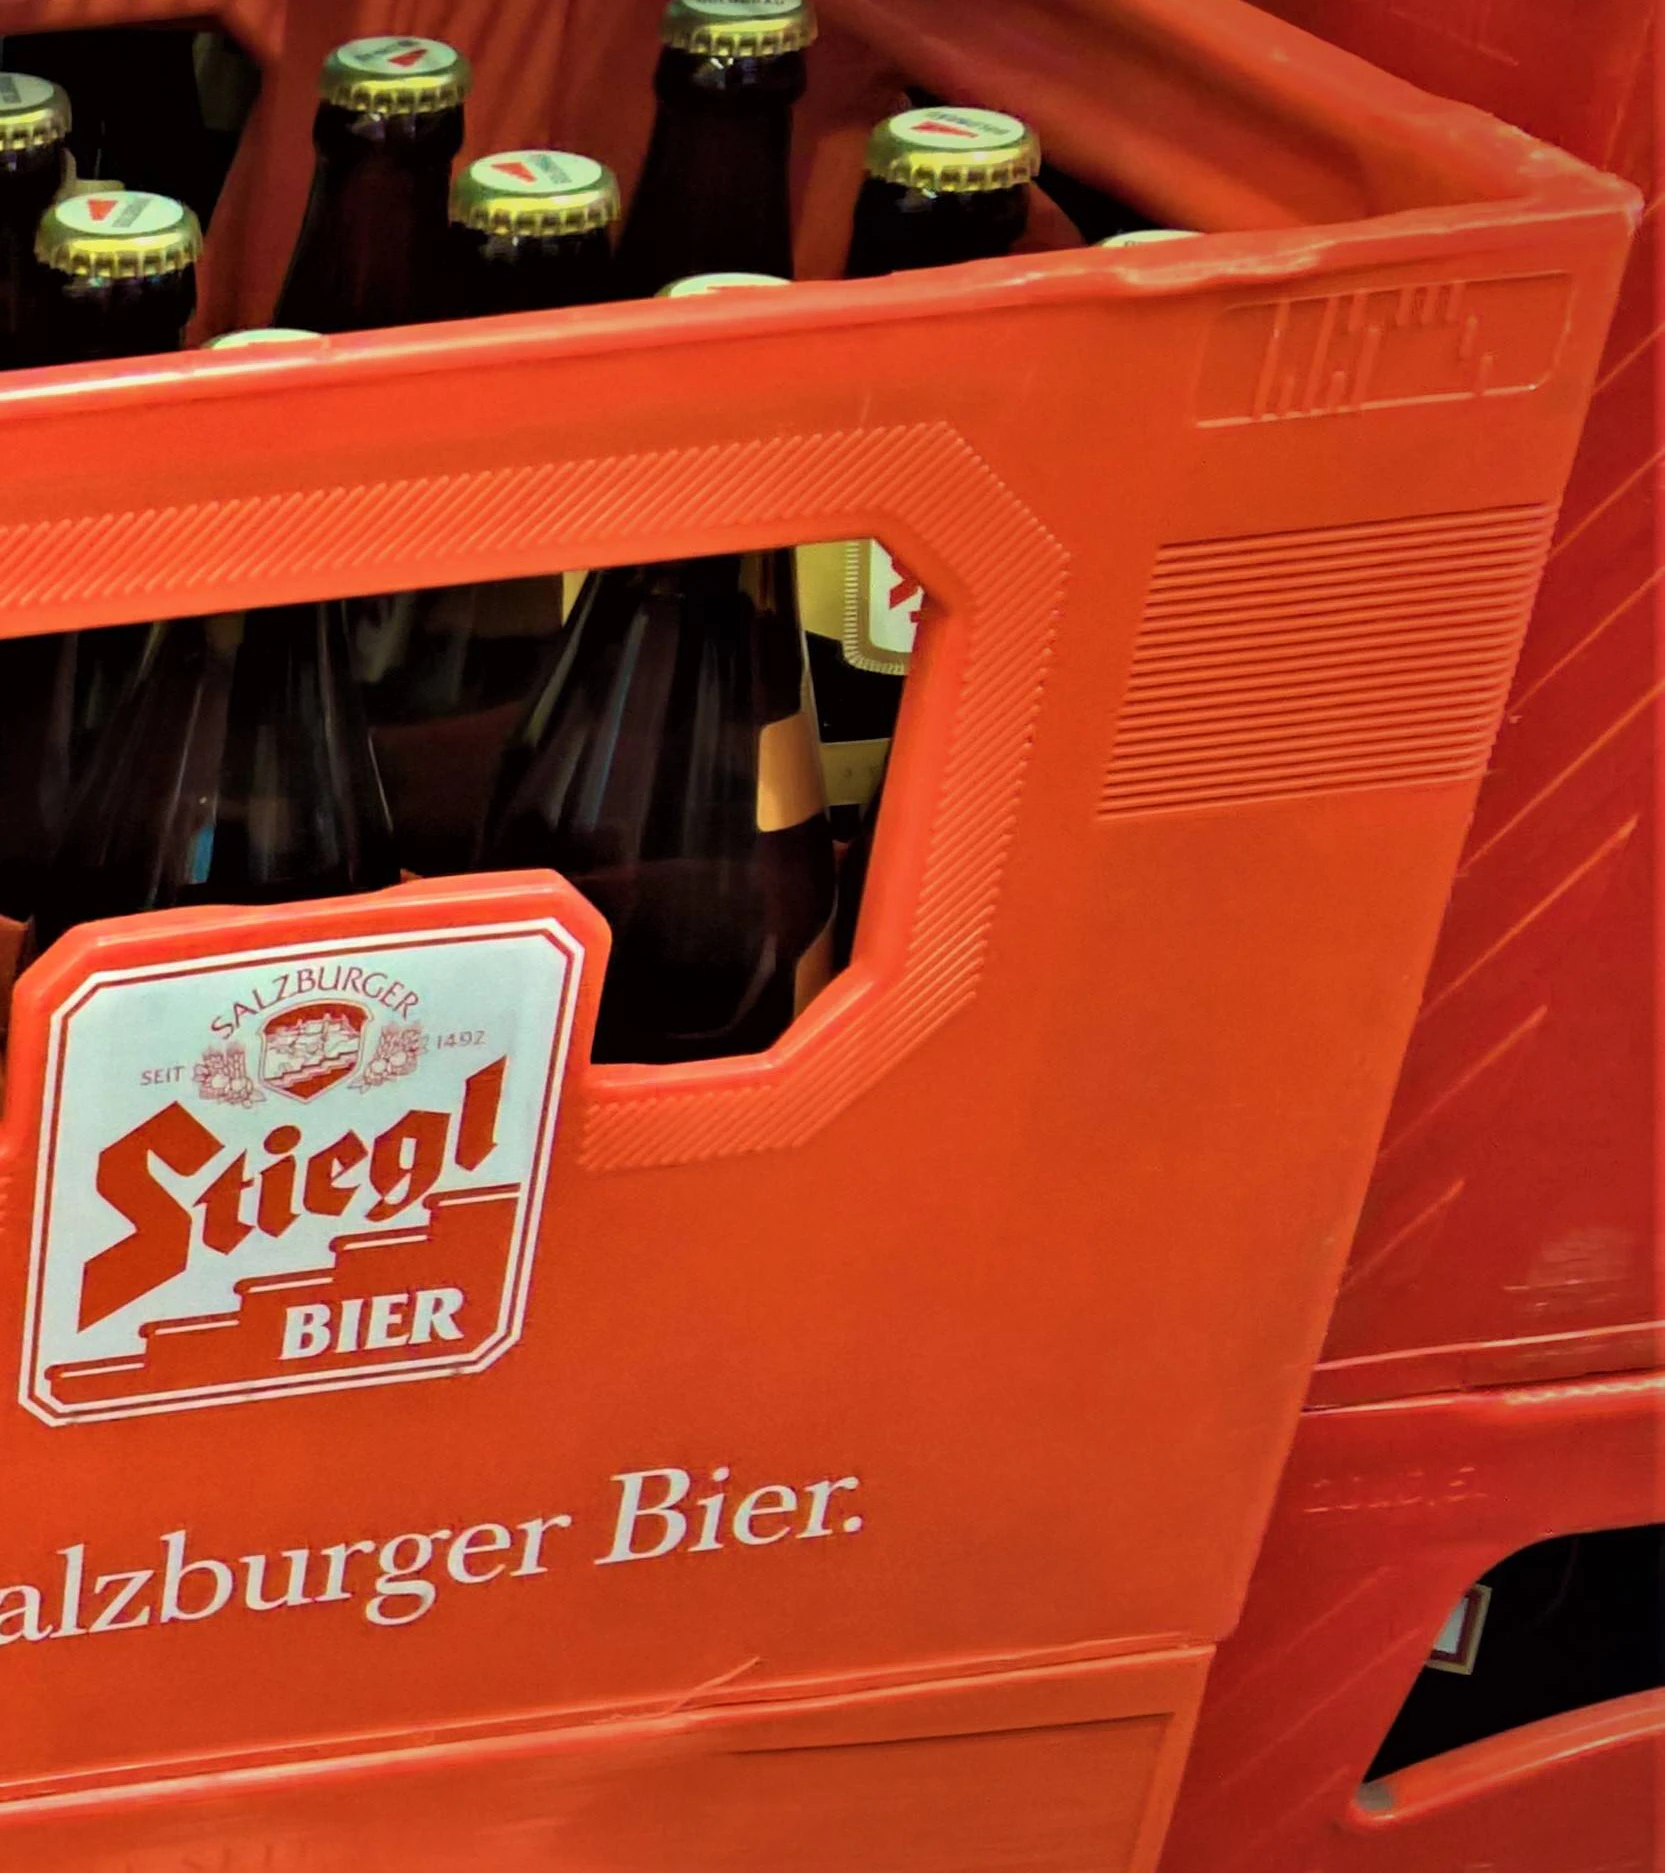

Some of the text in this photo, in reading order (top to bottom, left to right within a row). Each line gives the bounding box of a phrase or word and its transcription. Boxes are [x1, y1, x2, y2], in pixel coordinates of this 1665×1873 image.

[209, 965, 420, 1040] SALZBURGER
[139, 1029, 487, 1087] SEIT 1492
[77, 1055, 508, 1334] Stiegl
[279, 1287, 464, 1361] BIER
[593, 1465, 863, 1566] Bier.
